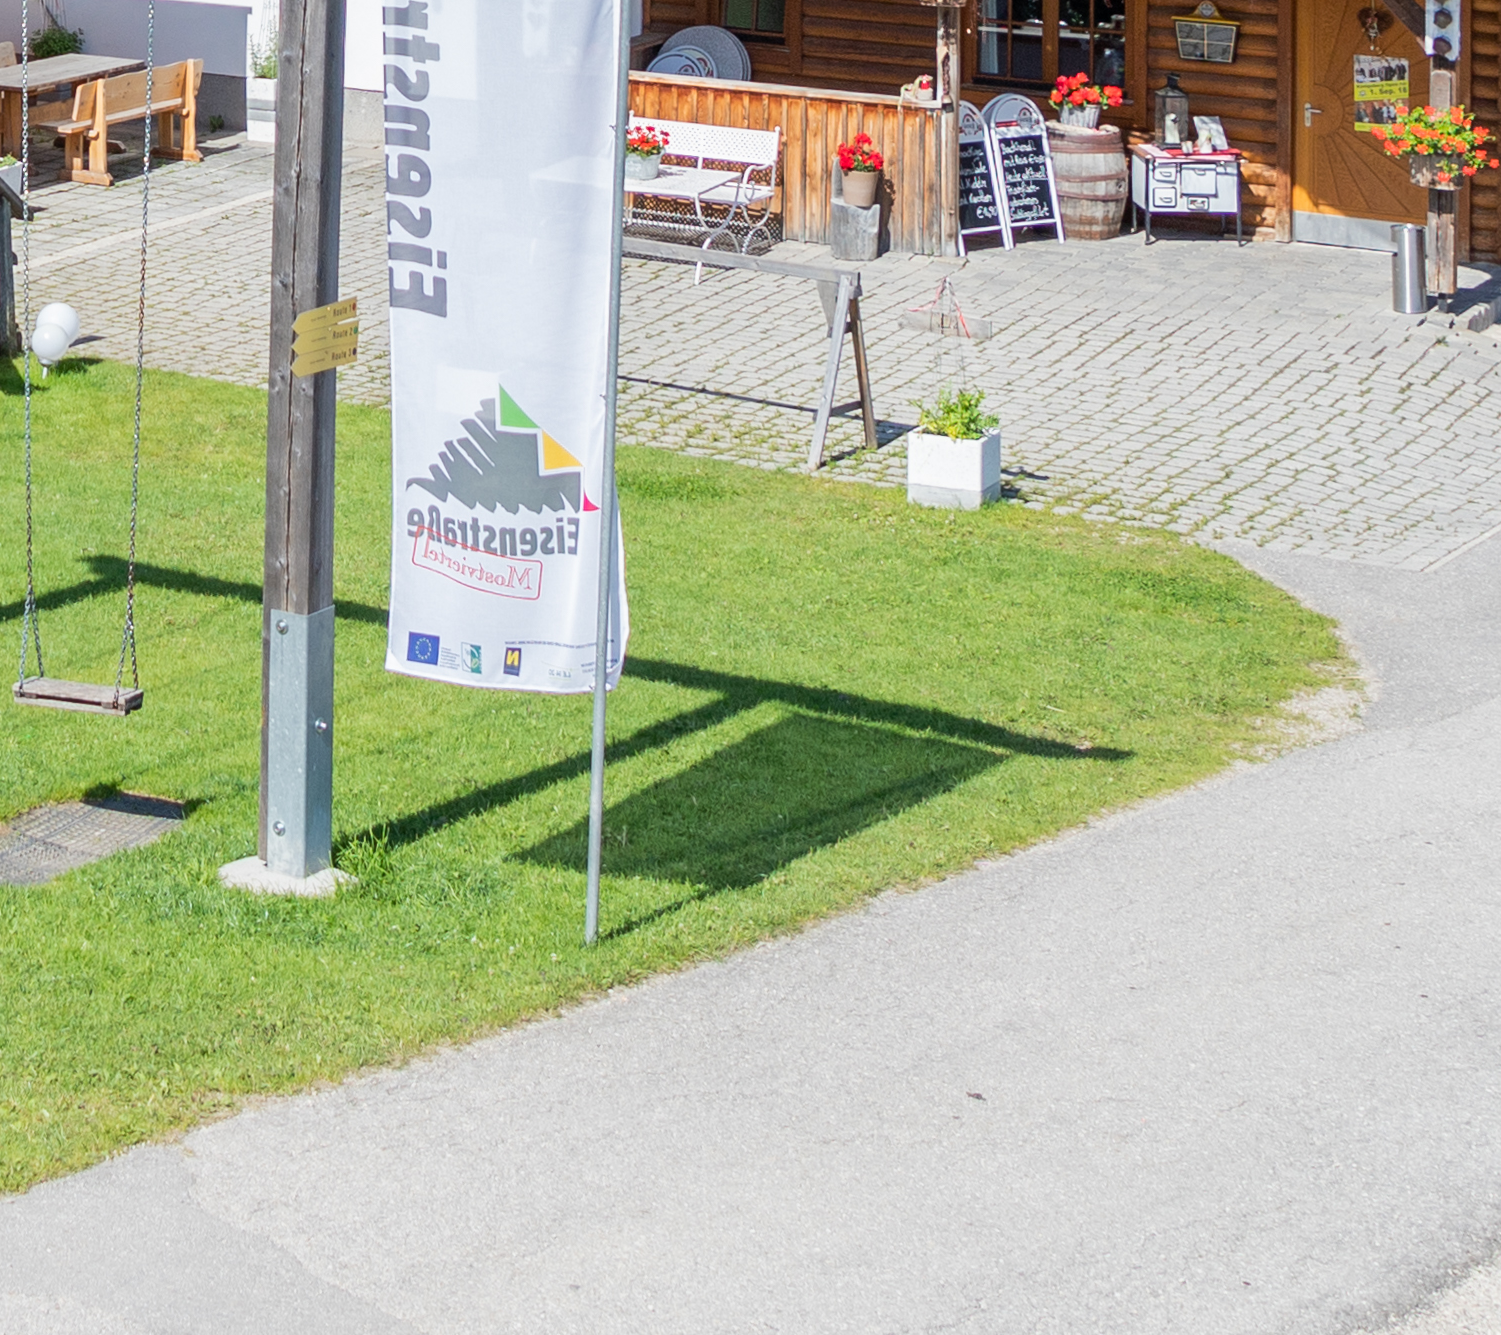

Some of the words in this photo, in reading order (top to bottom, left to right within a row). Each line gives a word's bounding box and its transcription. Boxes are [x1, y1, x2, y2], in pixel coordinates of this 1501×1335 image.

[333, 306, 348, 317] Route
[332, 329, 348, 340] Route
[332, 351, 347, 361] Route
